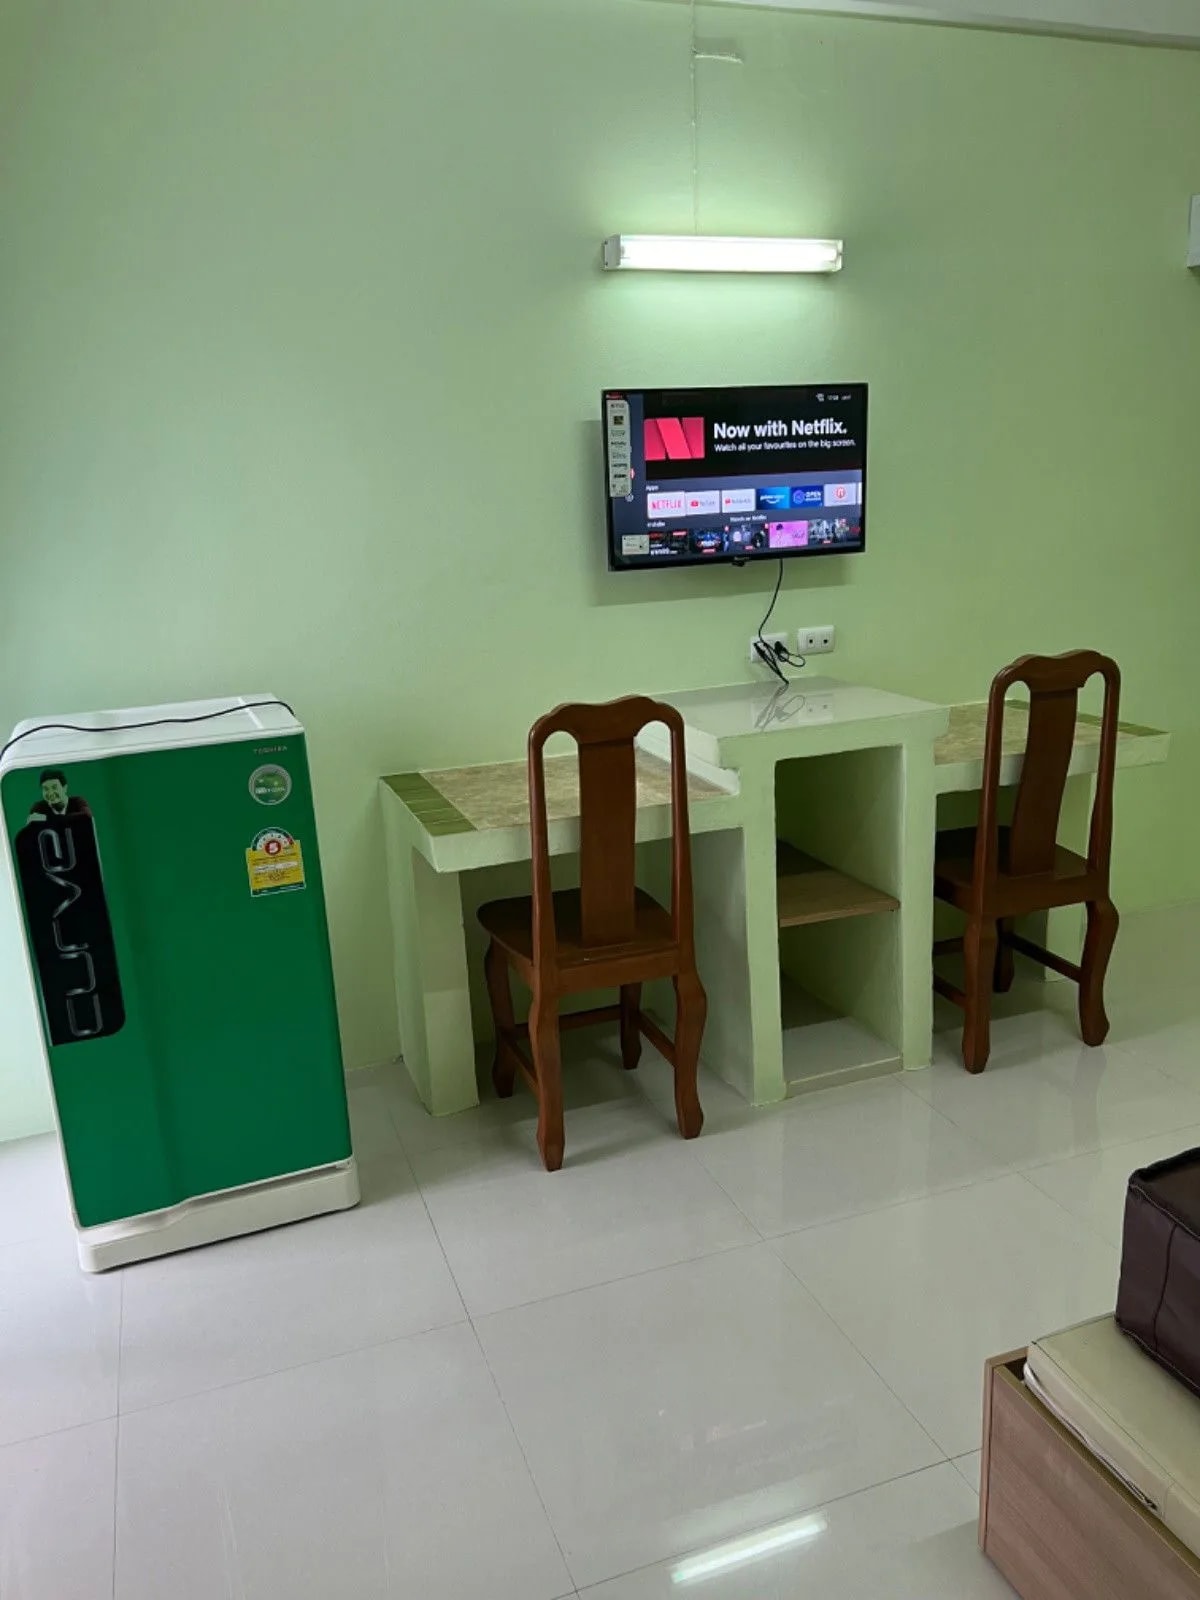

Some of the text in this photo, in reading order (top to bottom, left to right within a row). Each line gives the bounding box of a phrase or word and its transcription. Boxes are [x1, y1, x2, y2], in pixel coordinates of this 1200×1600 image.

[713, 417, 848, 439] Now with Netflix.
[714, 441, 737, 452] Watch
[738, 441, 747, 451] all
[747, 442, 762, 452] your
[763, 440, 797, 450] favourites
[799, 440, 807, 448] on
[808, 438, 819, 447] the
[820, 438, 831, 449] big
[651, 501, 682, 510] NETFLIX
